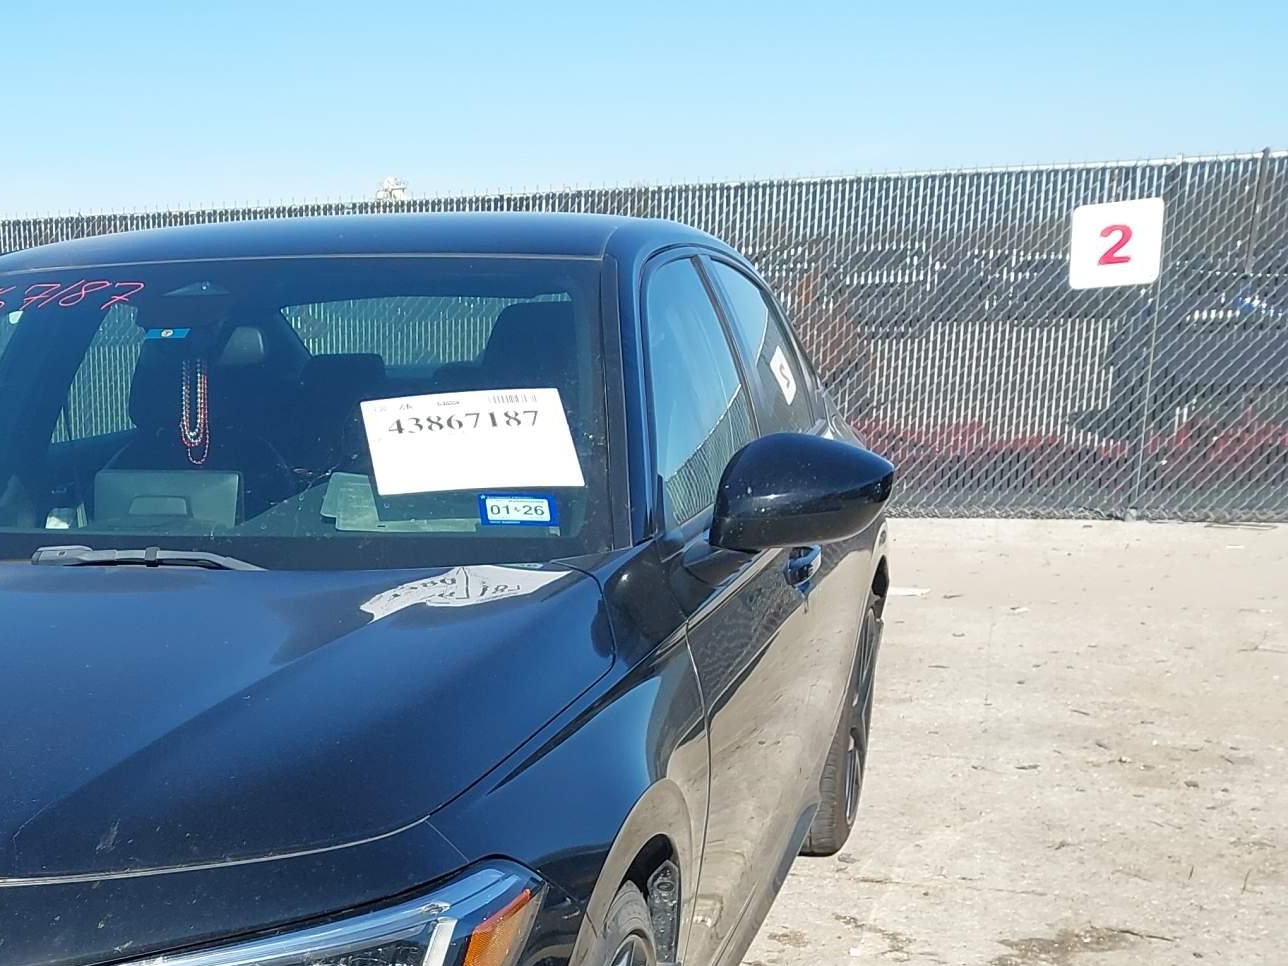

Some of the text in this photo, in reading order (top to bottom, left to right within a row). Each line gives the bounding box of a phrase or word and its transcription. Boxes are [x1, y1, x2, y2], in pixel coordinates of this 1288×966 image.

[1098, 224, 1133, 266] 2
[388, 410, 538, 434] 43867187
[522, 504, 545, 516] 26
